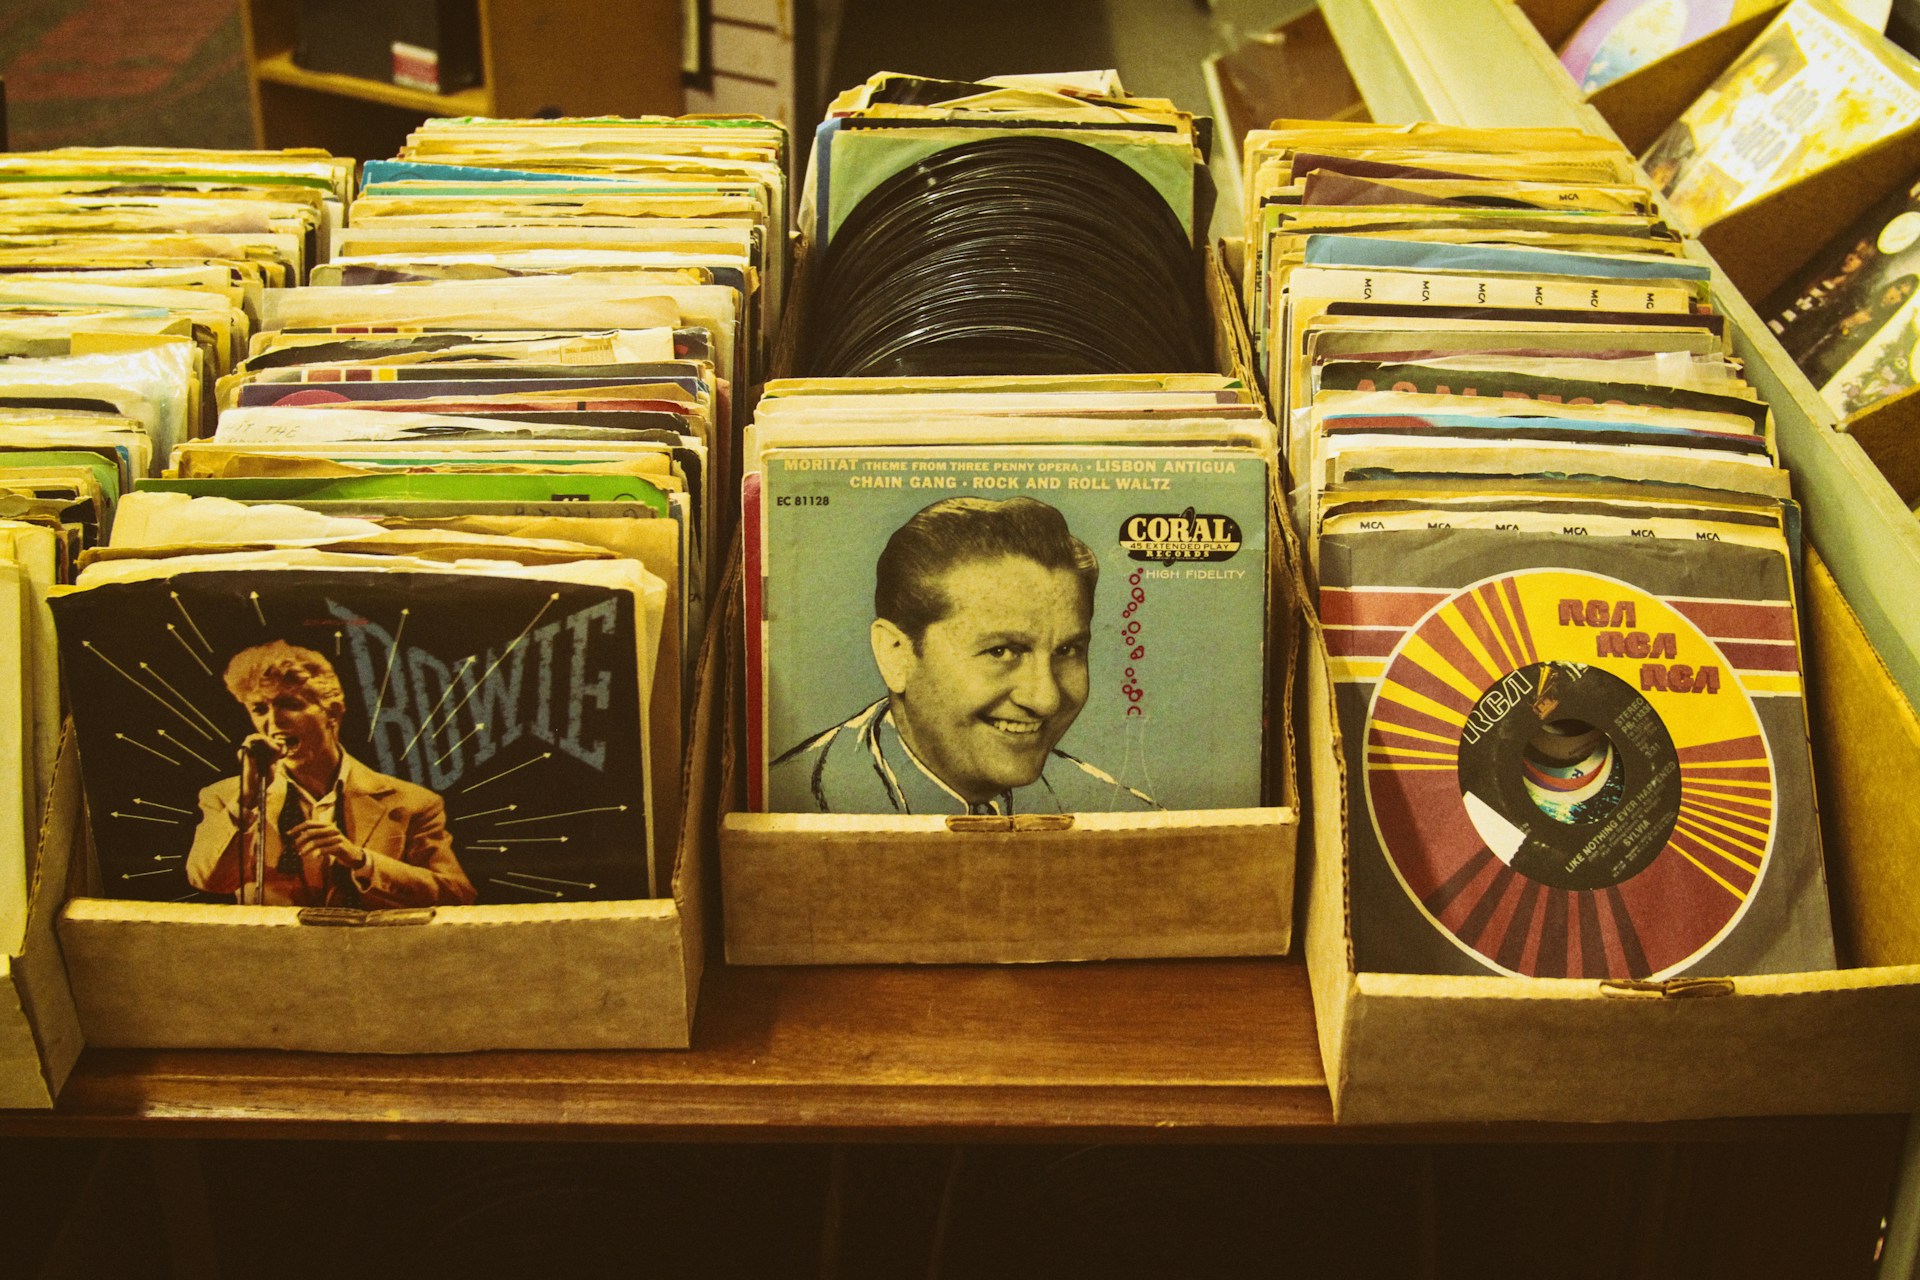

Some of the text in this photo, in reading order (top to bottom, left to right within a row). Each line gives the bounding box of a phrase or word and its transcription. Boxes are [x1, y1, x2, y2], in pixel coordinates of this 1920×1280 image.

[1558, 193, 1579, 201] MCA
[1364, 278, 1372, 300] MCA
[1422, 280, 1430, 302] MCA
[1590, 289, 1598, 308] MC
[265, 425, 300, 438] THE
[784, 458, 858, 471] MORITAT
[911, 461, 947, 472] FROM
[951, 462, 989, 472] THREE
[994, 462, 1036, 472] PENNY
[1096, 460, 1156, 473] LISBON
[1163, 460, 1236, 473] ANTIGUA
[849, 476, 1171, 490] CHAIN GANG ROCK AND ROLL WALTZ
[777, 496, 830, 506] EC 81128
[1127, 517, 1232, 542] CORAL
[1360, 521, 1385, 530] MCA
[1563, 527, 1588, 536] MCA
[1631, 529, 1656, 538] MCA
[1696, 532, 1720, 541] MCA
[1146, 569, 1246, 579] HIGH FIDELITY
[1558, 598, 1636, 628] RCA
[1596, 631, 1677, 660] RCA
[1639, 663, 1721, 694] RCA
[325, 597, 618, 791] BOWIE
[1462, 669, 1534, 745] RCA
[1614, 697, 1644, 727] STEREO
[1564, 852, 1585, 873] LIKE
[1582, 819, 1619, 856] NOTHING
[1616, 800, 1638, 822] EVER
[1636, 761, 1677, 801] HAPPENED
[1622, 819, 1650, 847] SYLVIA
